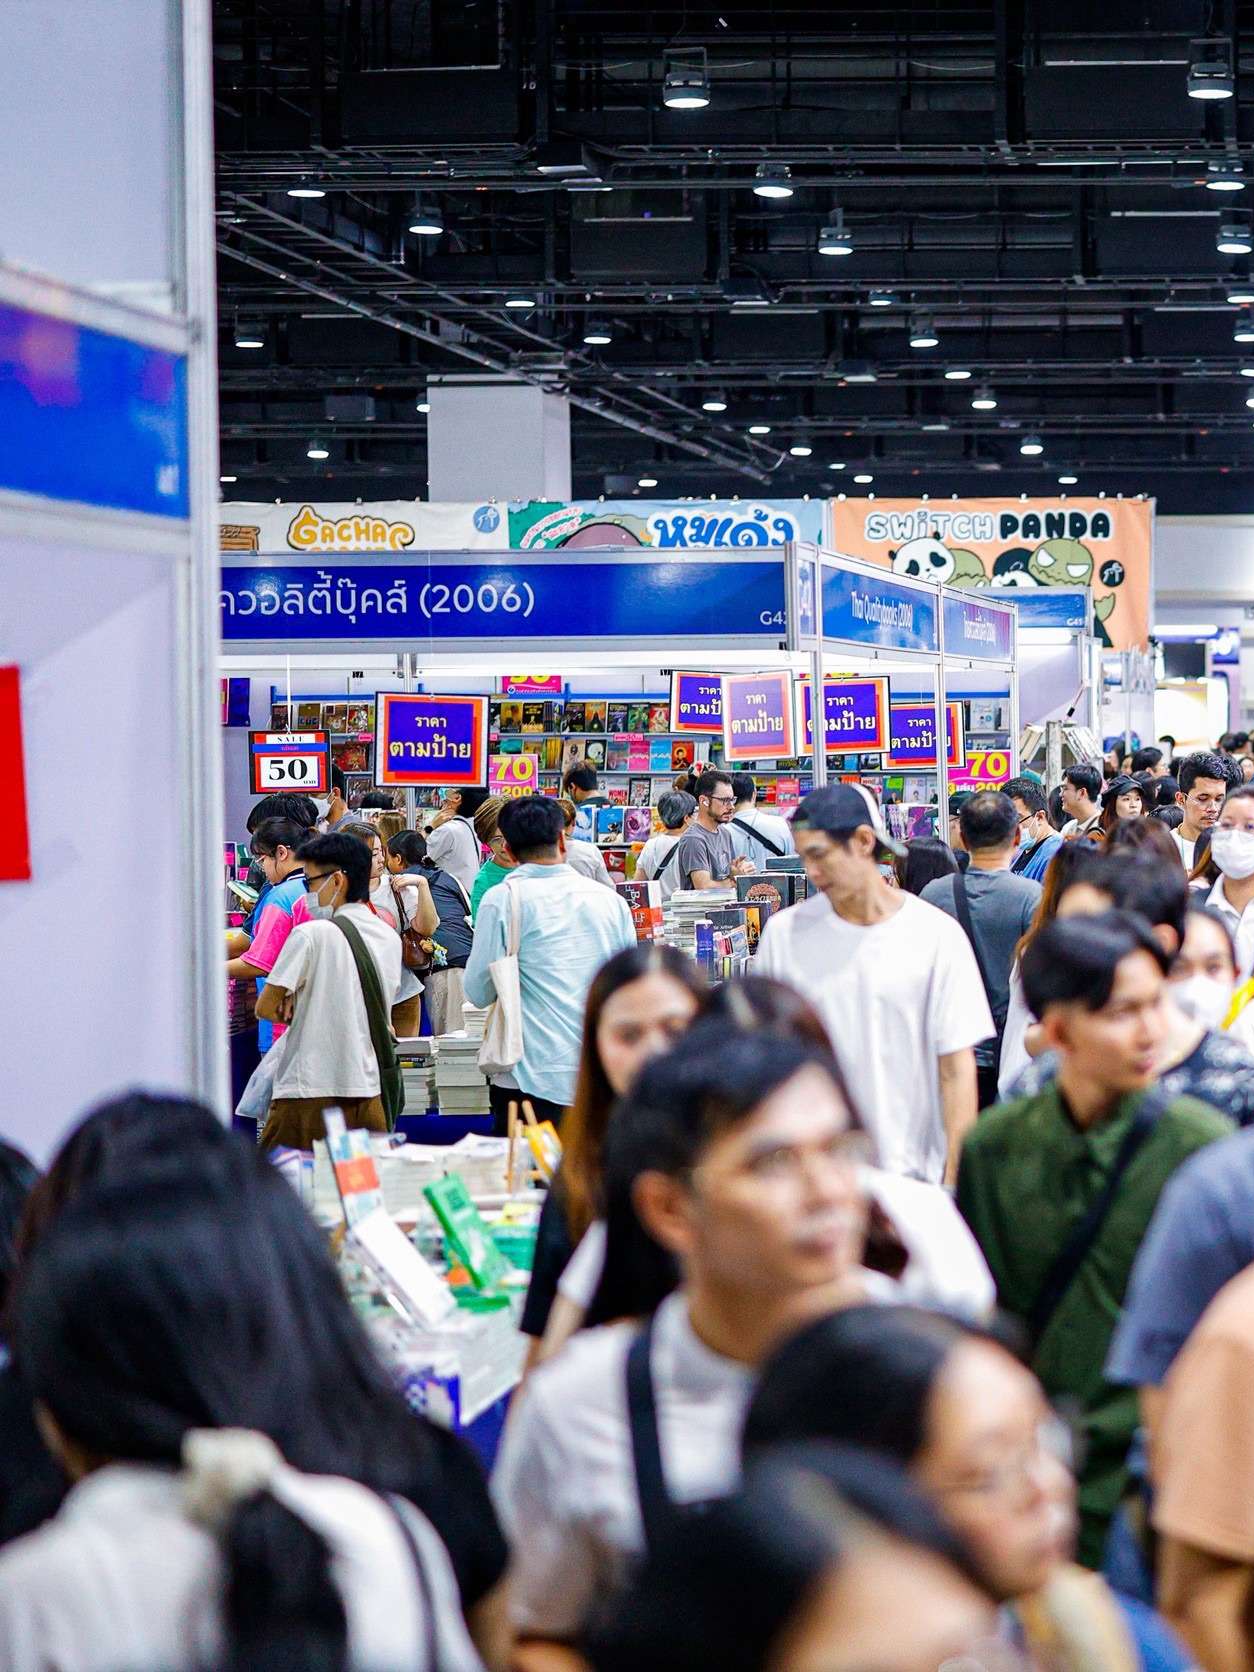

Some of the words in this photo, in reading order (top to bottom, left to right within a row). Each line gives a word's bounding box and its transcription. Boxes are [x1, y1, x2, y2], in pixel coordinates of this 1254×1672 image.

[653, 508, 794, 548] หมเด้ง
[1000, 513, 1110, 540] PANDA
[419, 581, 535, 619] (2006)
[851, 590, 863, 619] Thai
[680, 698, 722, 715] ตามป้
[745, 693, 767, 705] ราคา
[826, 696, 854, 707] ราคา
[414, 715, 447, 728] ราคา
[731, 710, 784, 734] ตามป้าย
[907, 718, 932, 728] ราคา
[389, 734, 472, 759] ตามป้าย
[268, 758, 308, 781] 50
[492, 755, 534, 781] 70
[966, 752, 1008, 777] 70
[501, 785, 533, 799] 200
